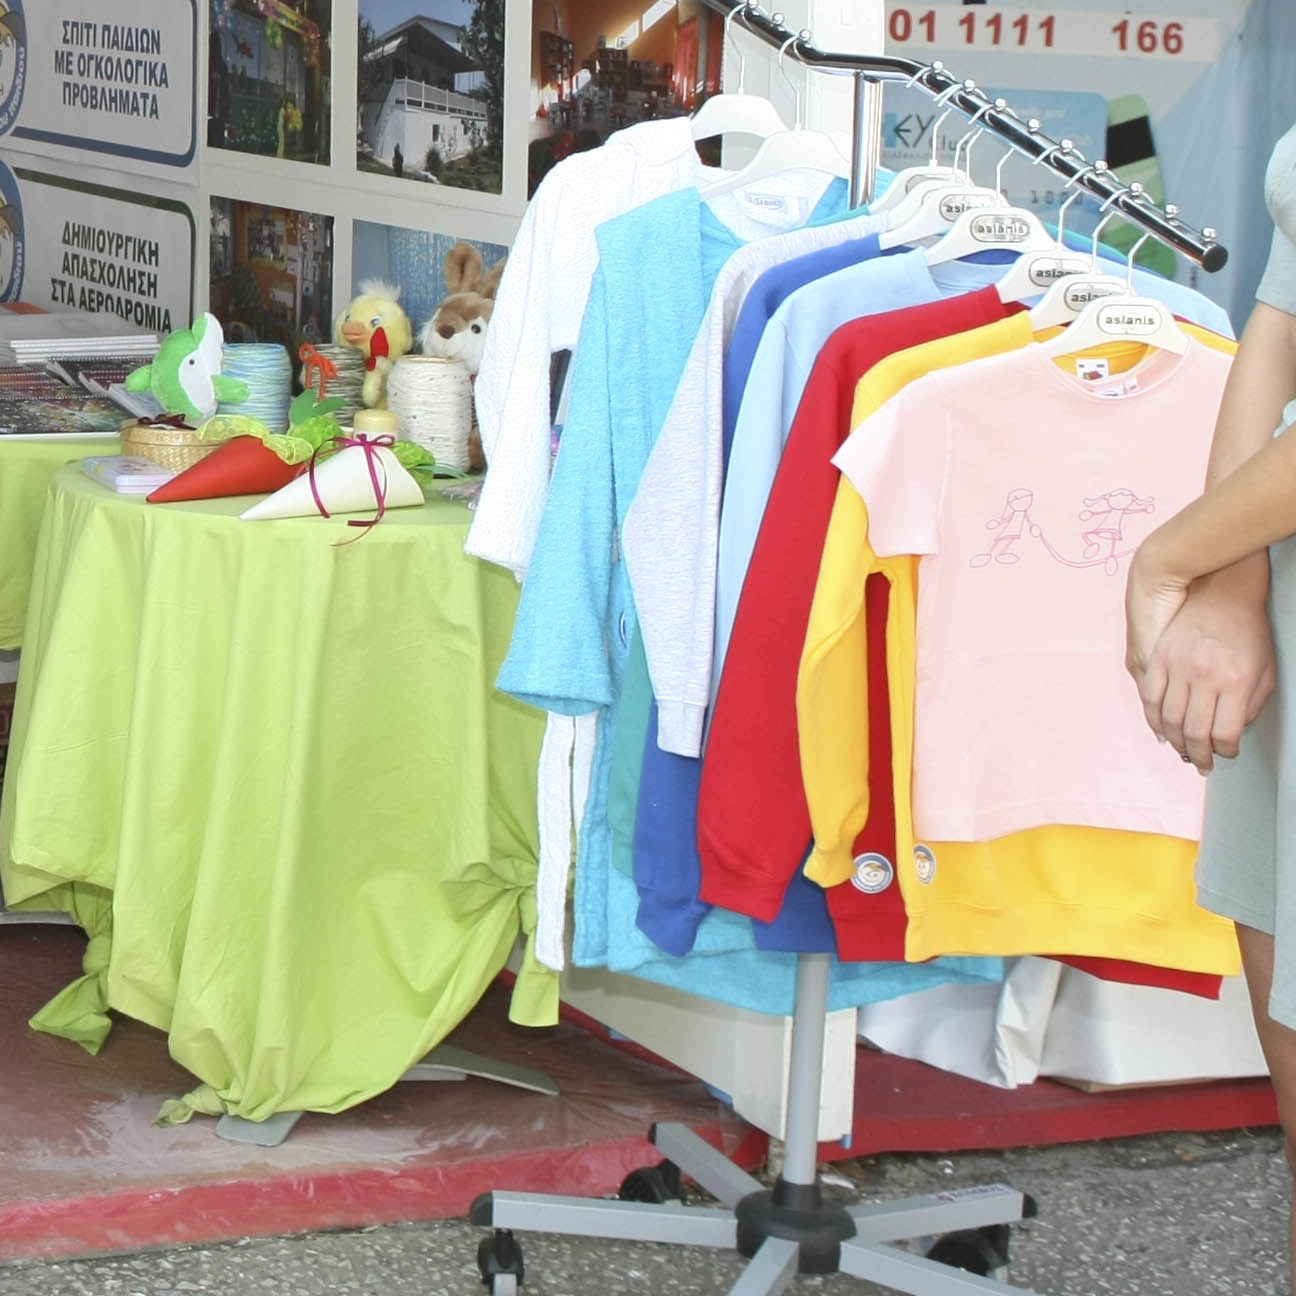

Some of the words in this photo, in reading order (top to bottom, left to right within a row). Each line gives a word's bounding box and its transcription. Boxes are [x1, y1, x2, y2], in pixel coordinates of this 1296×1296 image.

[62, 20, 96, 45] ΣΠΙΤΙ
[101, 23, 160, 55] ΠΑΙΔΙΩΝ
[959, 14, 1056, 48] 1111
[1112, 19, 1184, 54] 166
[54, 51, 74, 75] ΜΕ
[77, 54, 169, 88] ΟΓΚΟΛΟΓΙΚΑ
[62, 81, 159, 120] ΠΡΟΒΛΗΜΑΤΑ
[62, 221, 159, 267] ΔΗΜΙΟΥΡΓΙΚΗ
[50, 278, 75, 305] ΣΤΑ
[62, 251, 157, 299] ΑΠΑΣΧΟΛΗΣΗ
[1105, 315, 1155, 327] aslanis
